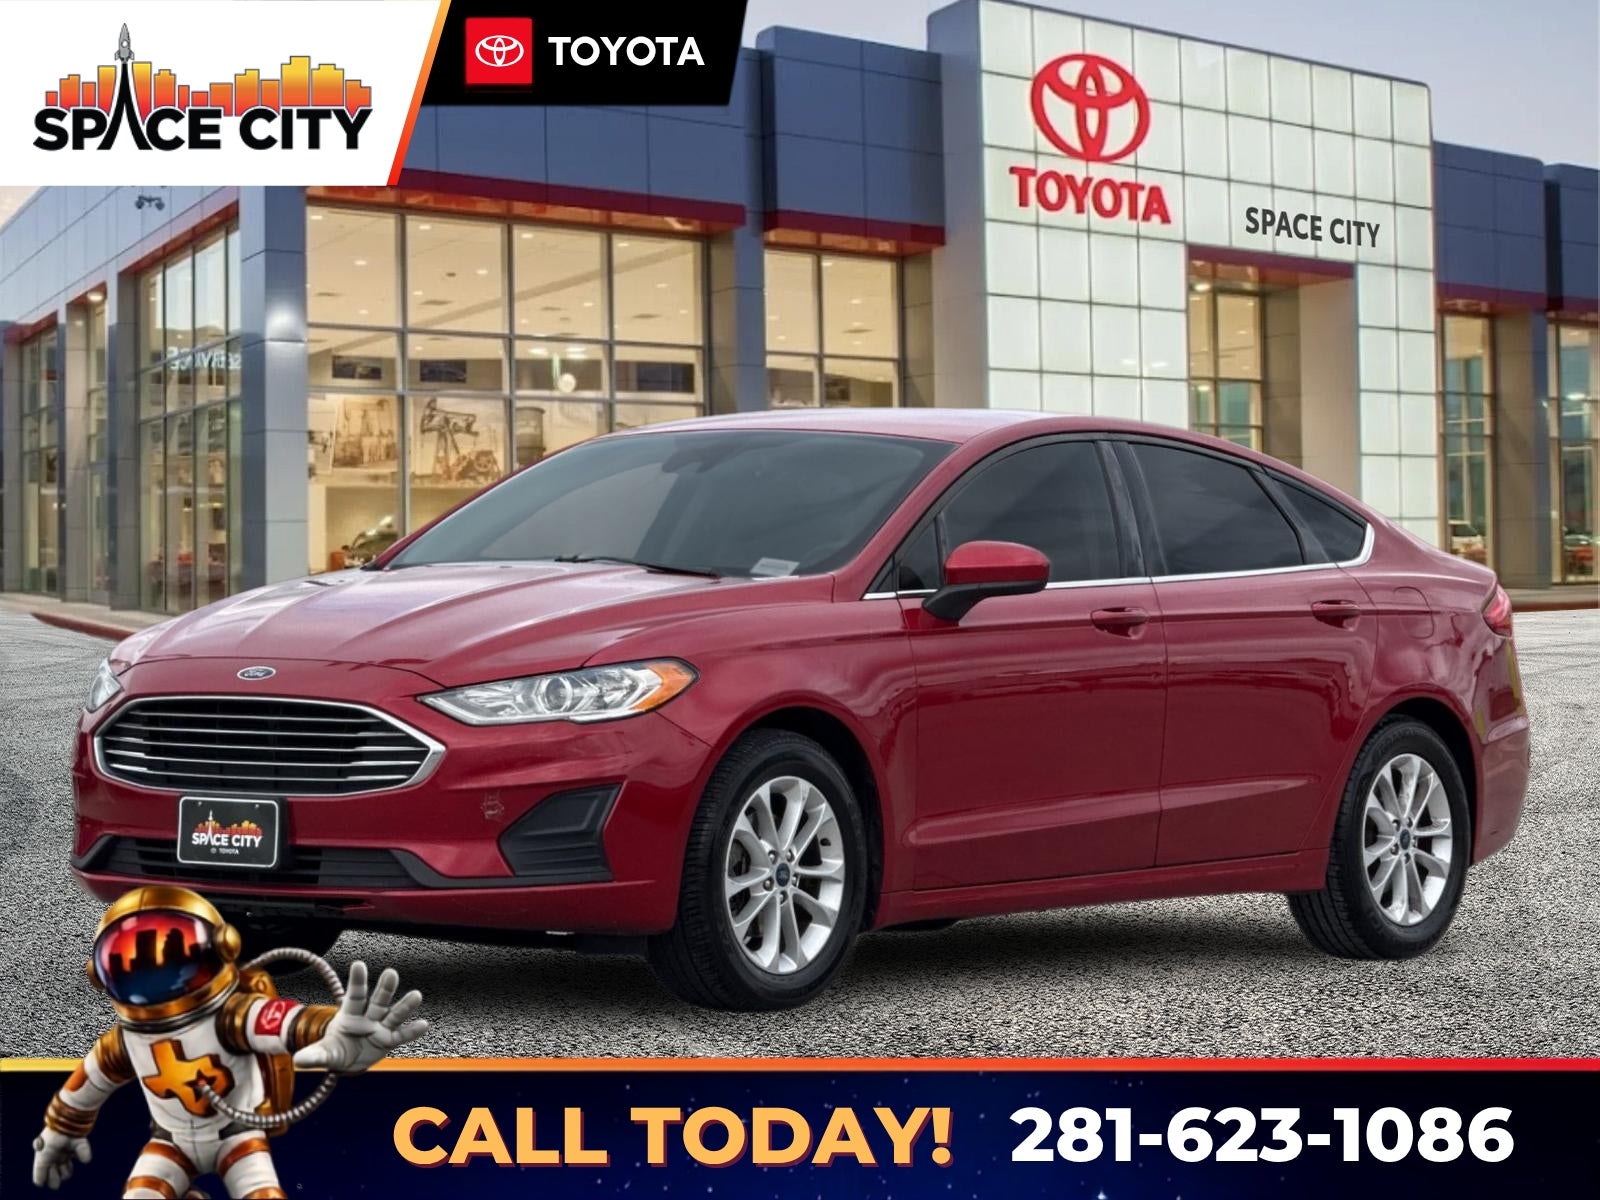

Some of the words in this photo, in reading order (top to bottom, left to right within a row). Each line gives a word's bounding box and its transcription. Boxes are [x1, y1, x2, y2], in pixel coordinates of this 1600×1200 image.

[1009, 166, 1171, 225] TOYOTA
[1245, 206, 1322, 242] SPACE
[1329, 217, 1381, 248] CITY
[191, 830, 229, 846] SPACE
[231, 834, 263, 848] CITY
